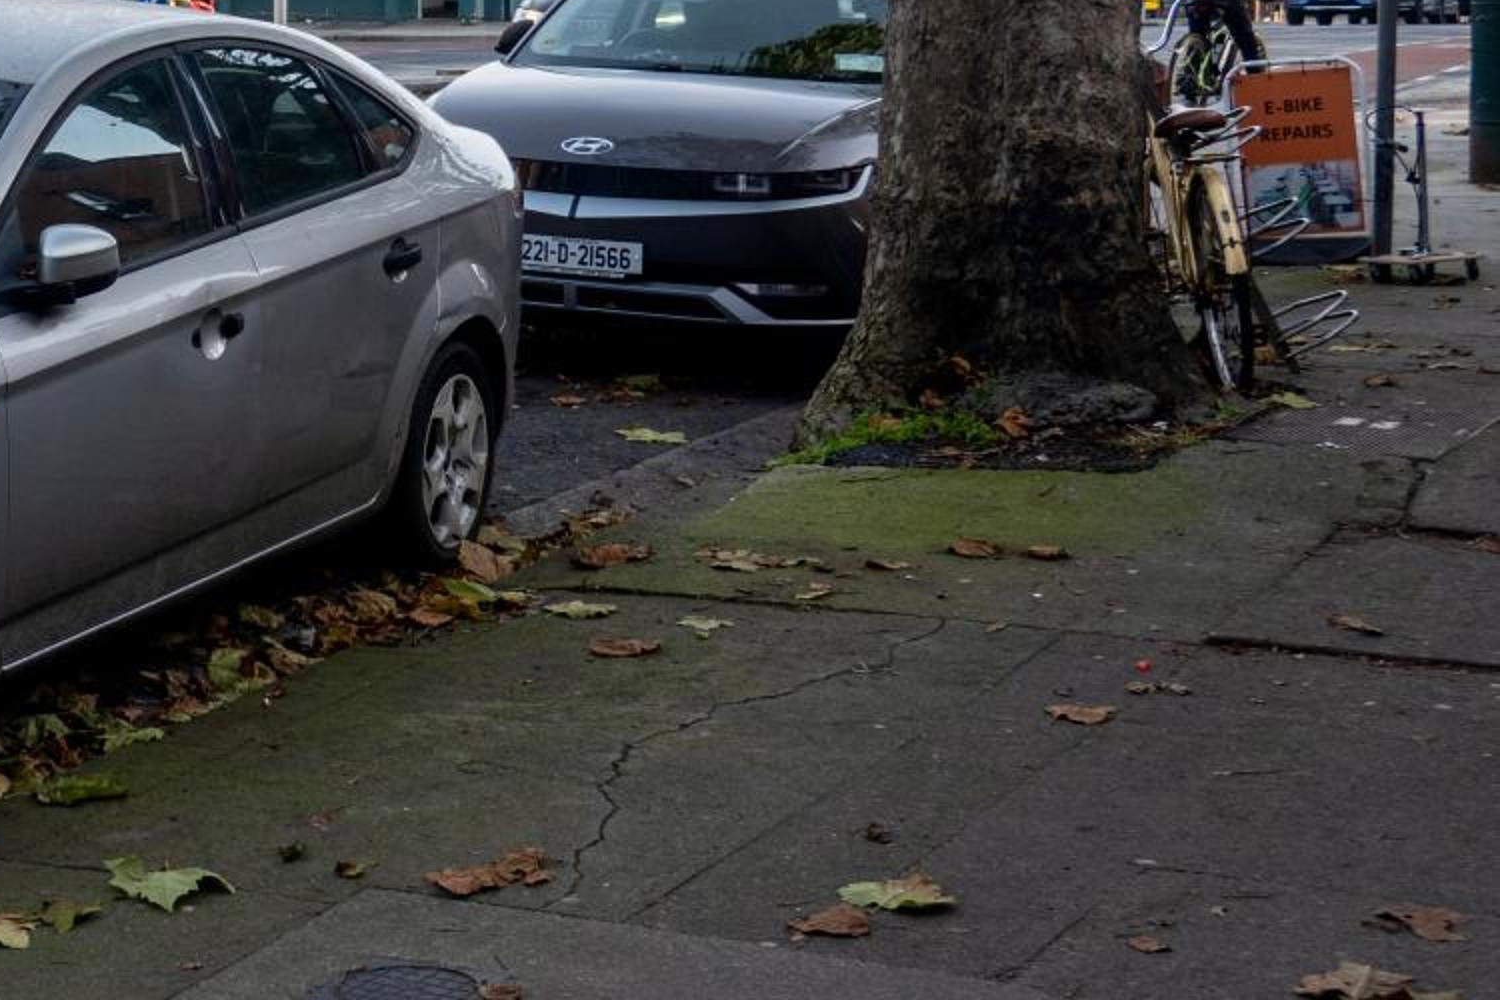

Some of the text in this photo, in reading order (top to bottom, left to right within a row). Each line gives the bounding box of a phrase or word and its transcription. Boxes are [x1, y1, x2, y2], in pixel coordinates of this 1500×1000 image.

[1264, 97, 1325, 115] E-BIKE
[1260, 124, 1333, 142] REPAIRS
[522, 240, 631, 269] 221-D-21566
